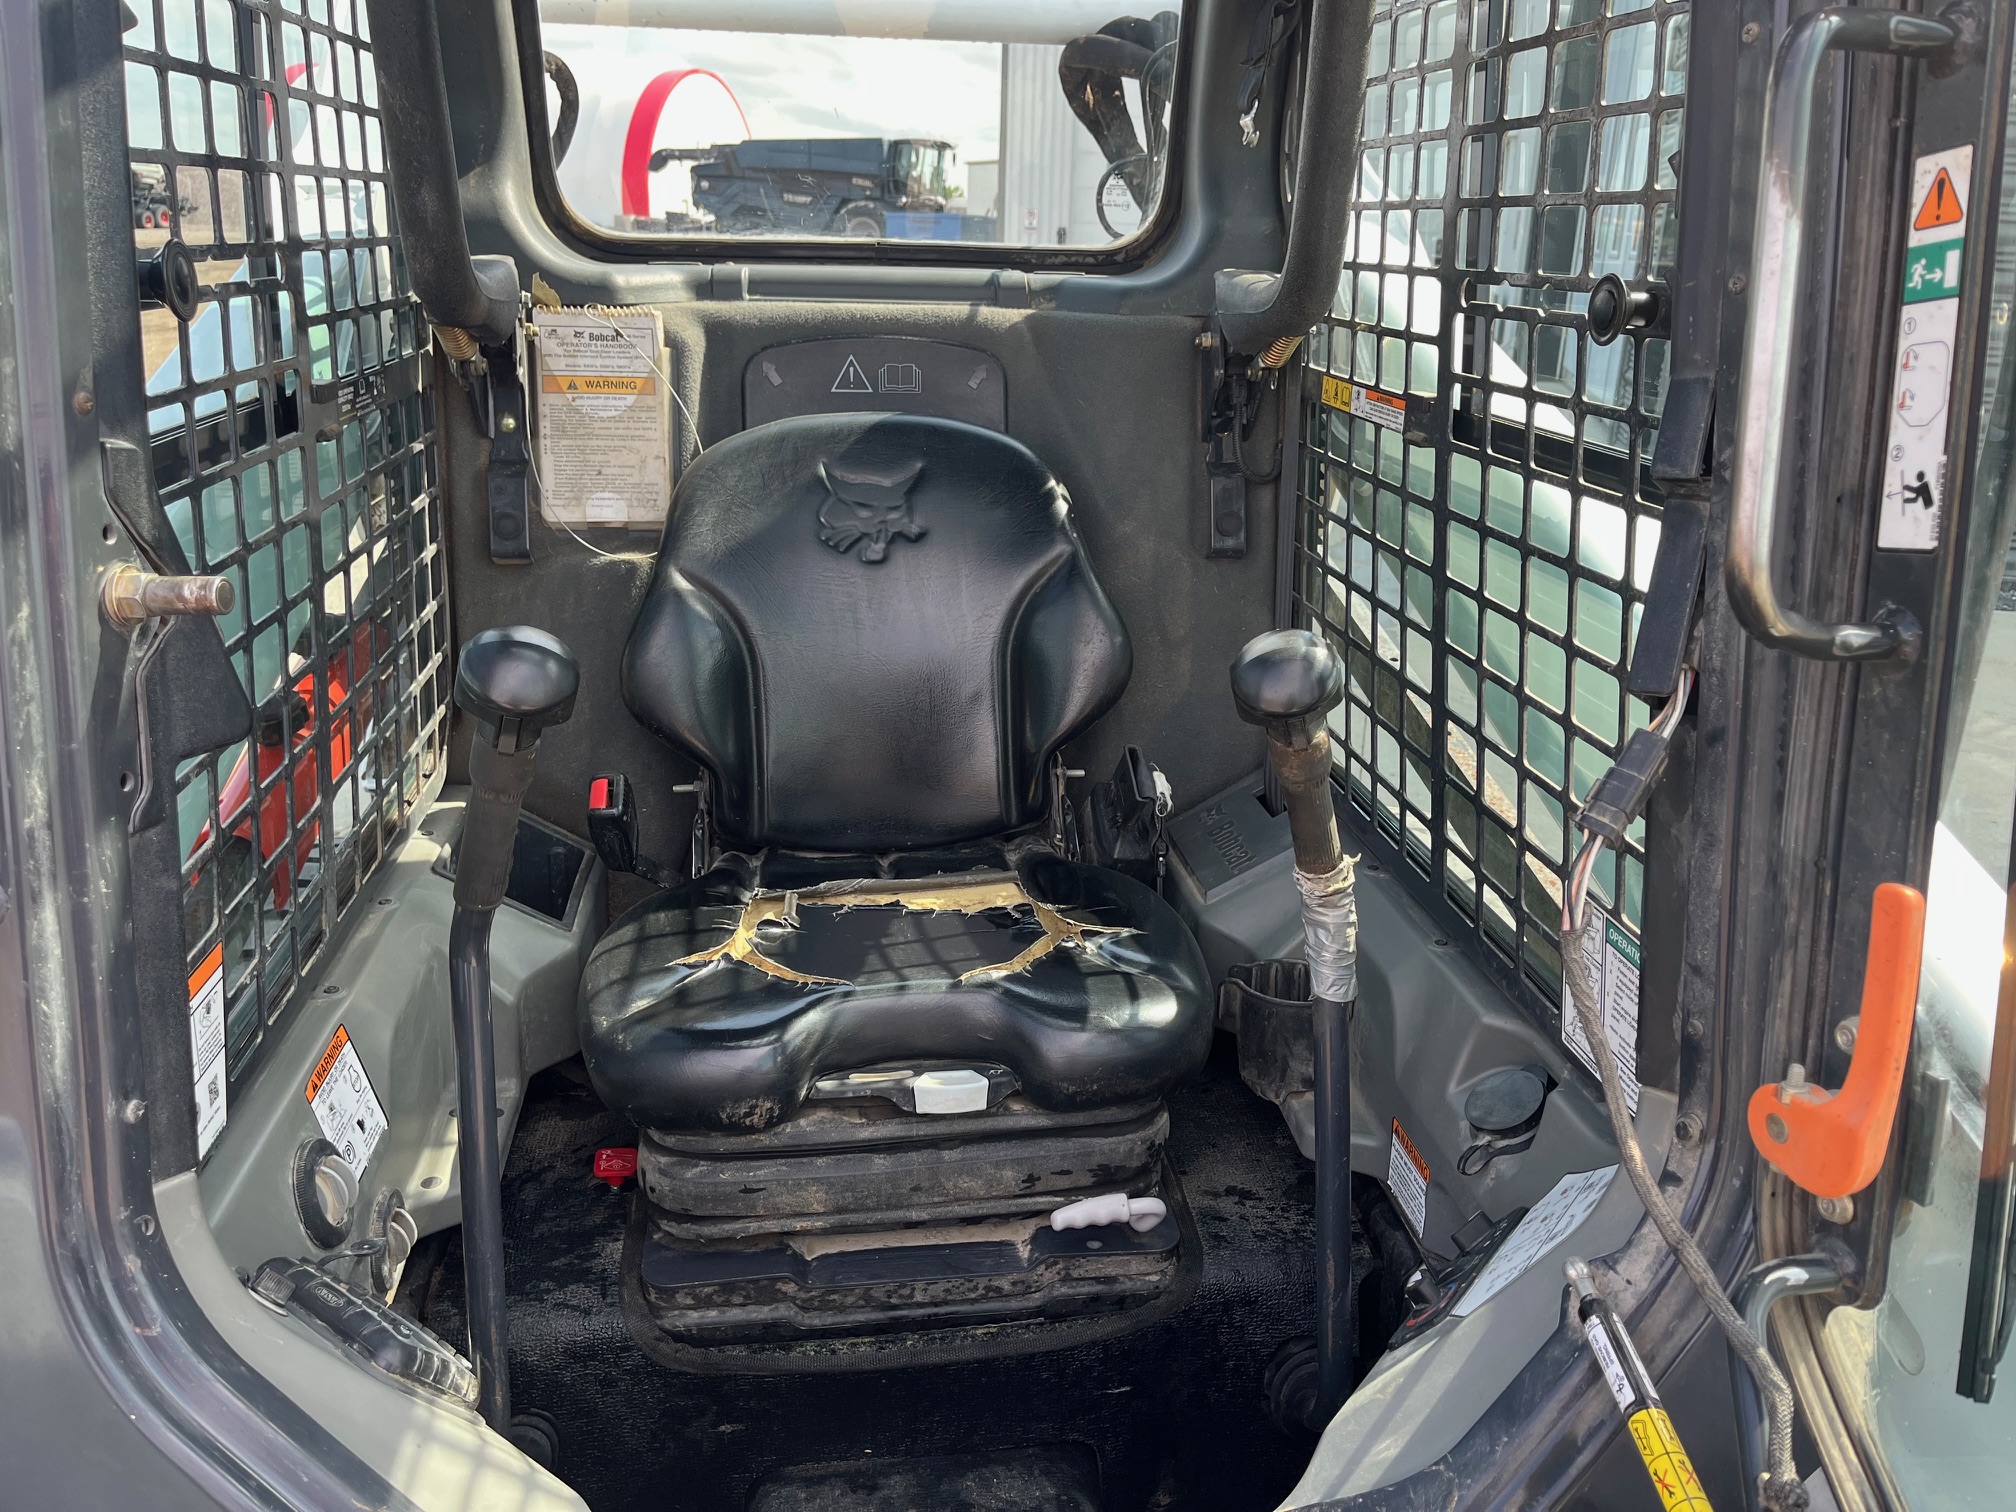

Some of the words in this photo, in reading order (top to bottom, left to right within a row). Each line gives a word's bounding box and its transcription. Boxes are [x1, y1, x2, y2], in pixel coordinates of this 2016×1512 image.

[556, 341, 599, 349] OPERATOR'S
[588, 332, 621, 343] Bobcat
[585, 380, 637, 390] WARNING
[1207, 819, 1258, 871] Bobcat
[315, 1035, 343, 1082] WARNING
[1398, 1127, 1428, 1180] WARNING
